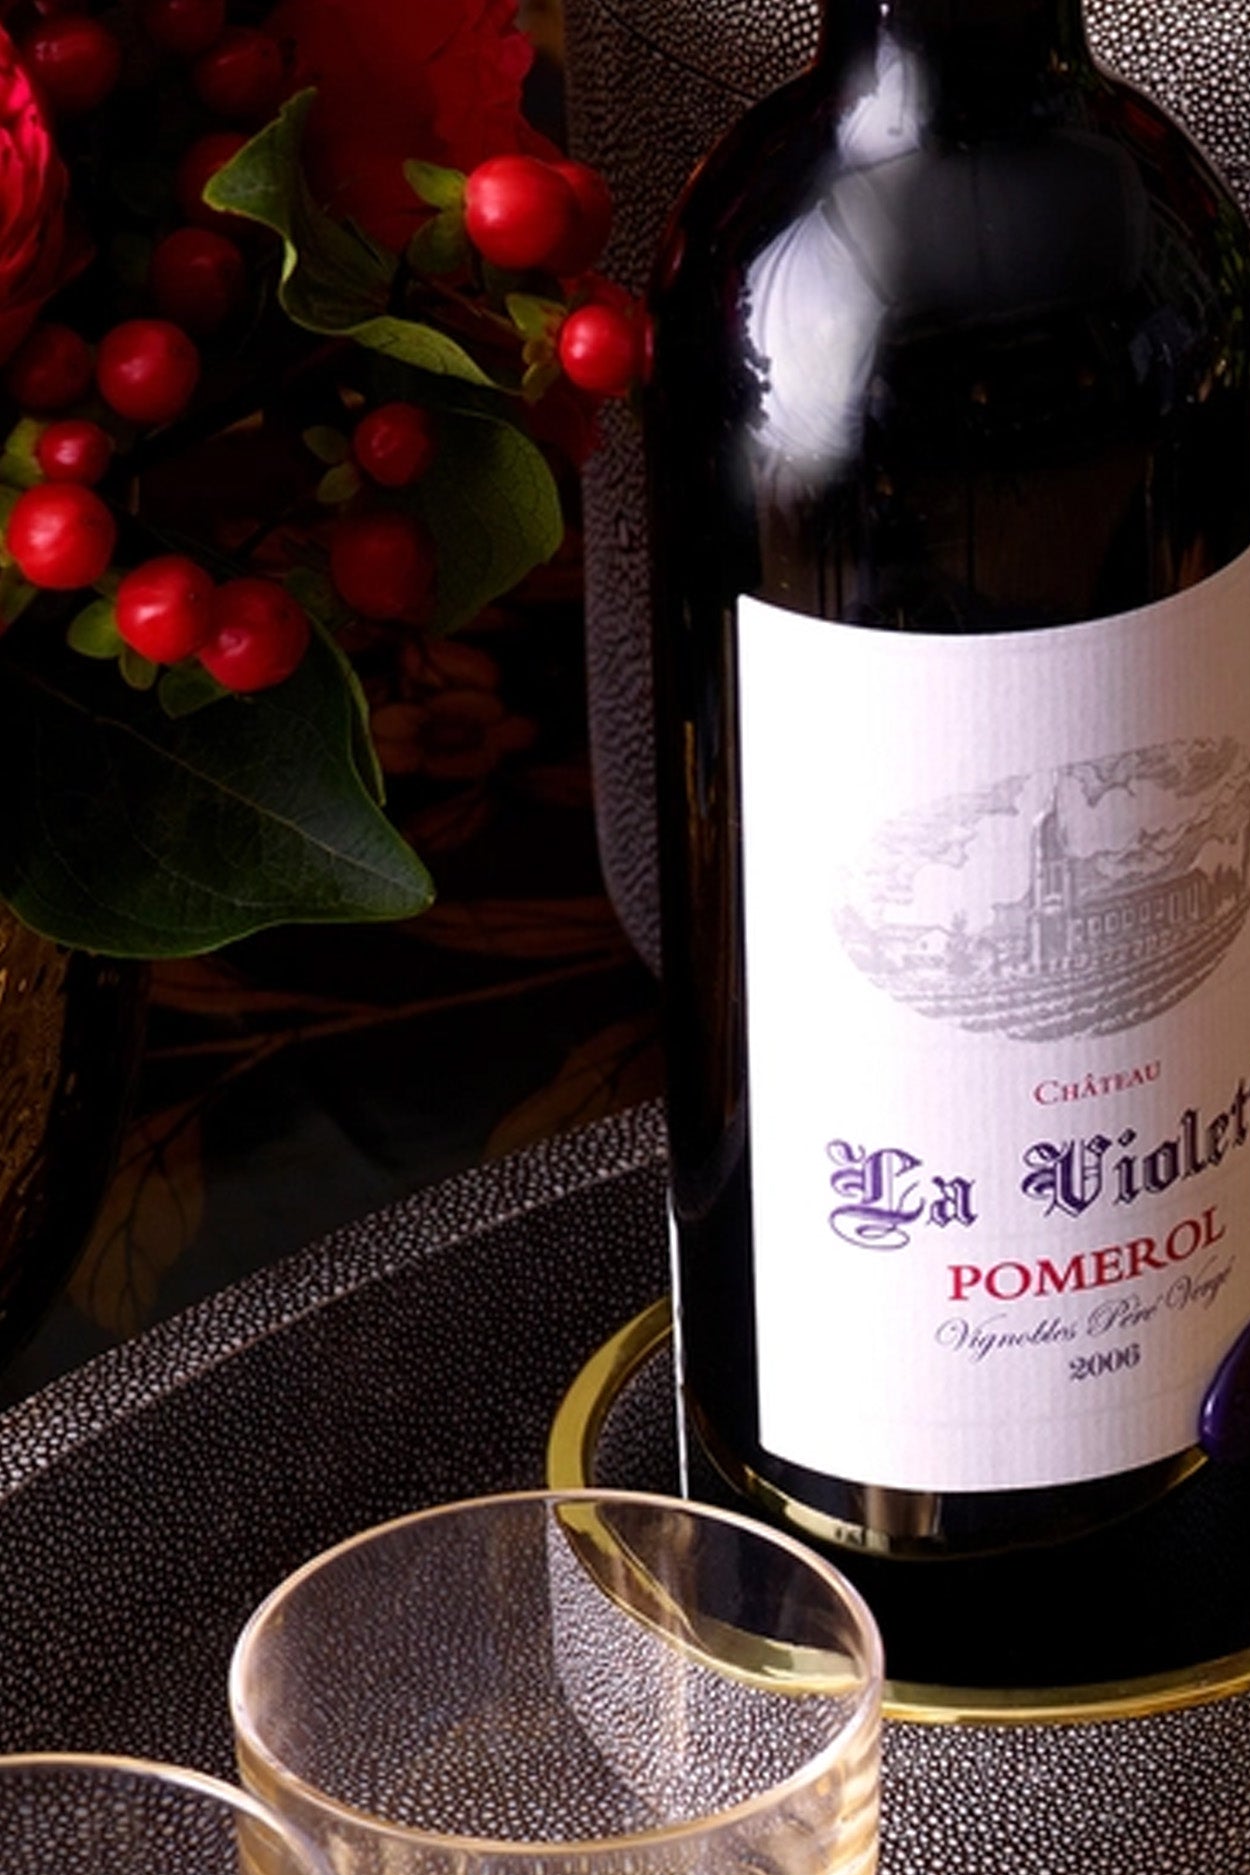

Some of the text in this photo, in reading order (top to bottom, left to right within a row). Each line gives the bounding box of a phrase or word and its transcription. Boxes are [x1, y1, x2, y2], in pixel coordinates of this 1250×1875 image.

[826, 1139, 978, 1251] La
[947, 1206, 1226, 1301] POMEROL
[935, 1313, 1077, 1363] Vignobles
[1070, 1343, 1141, 1381] 2006
